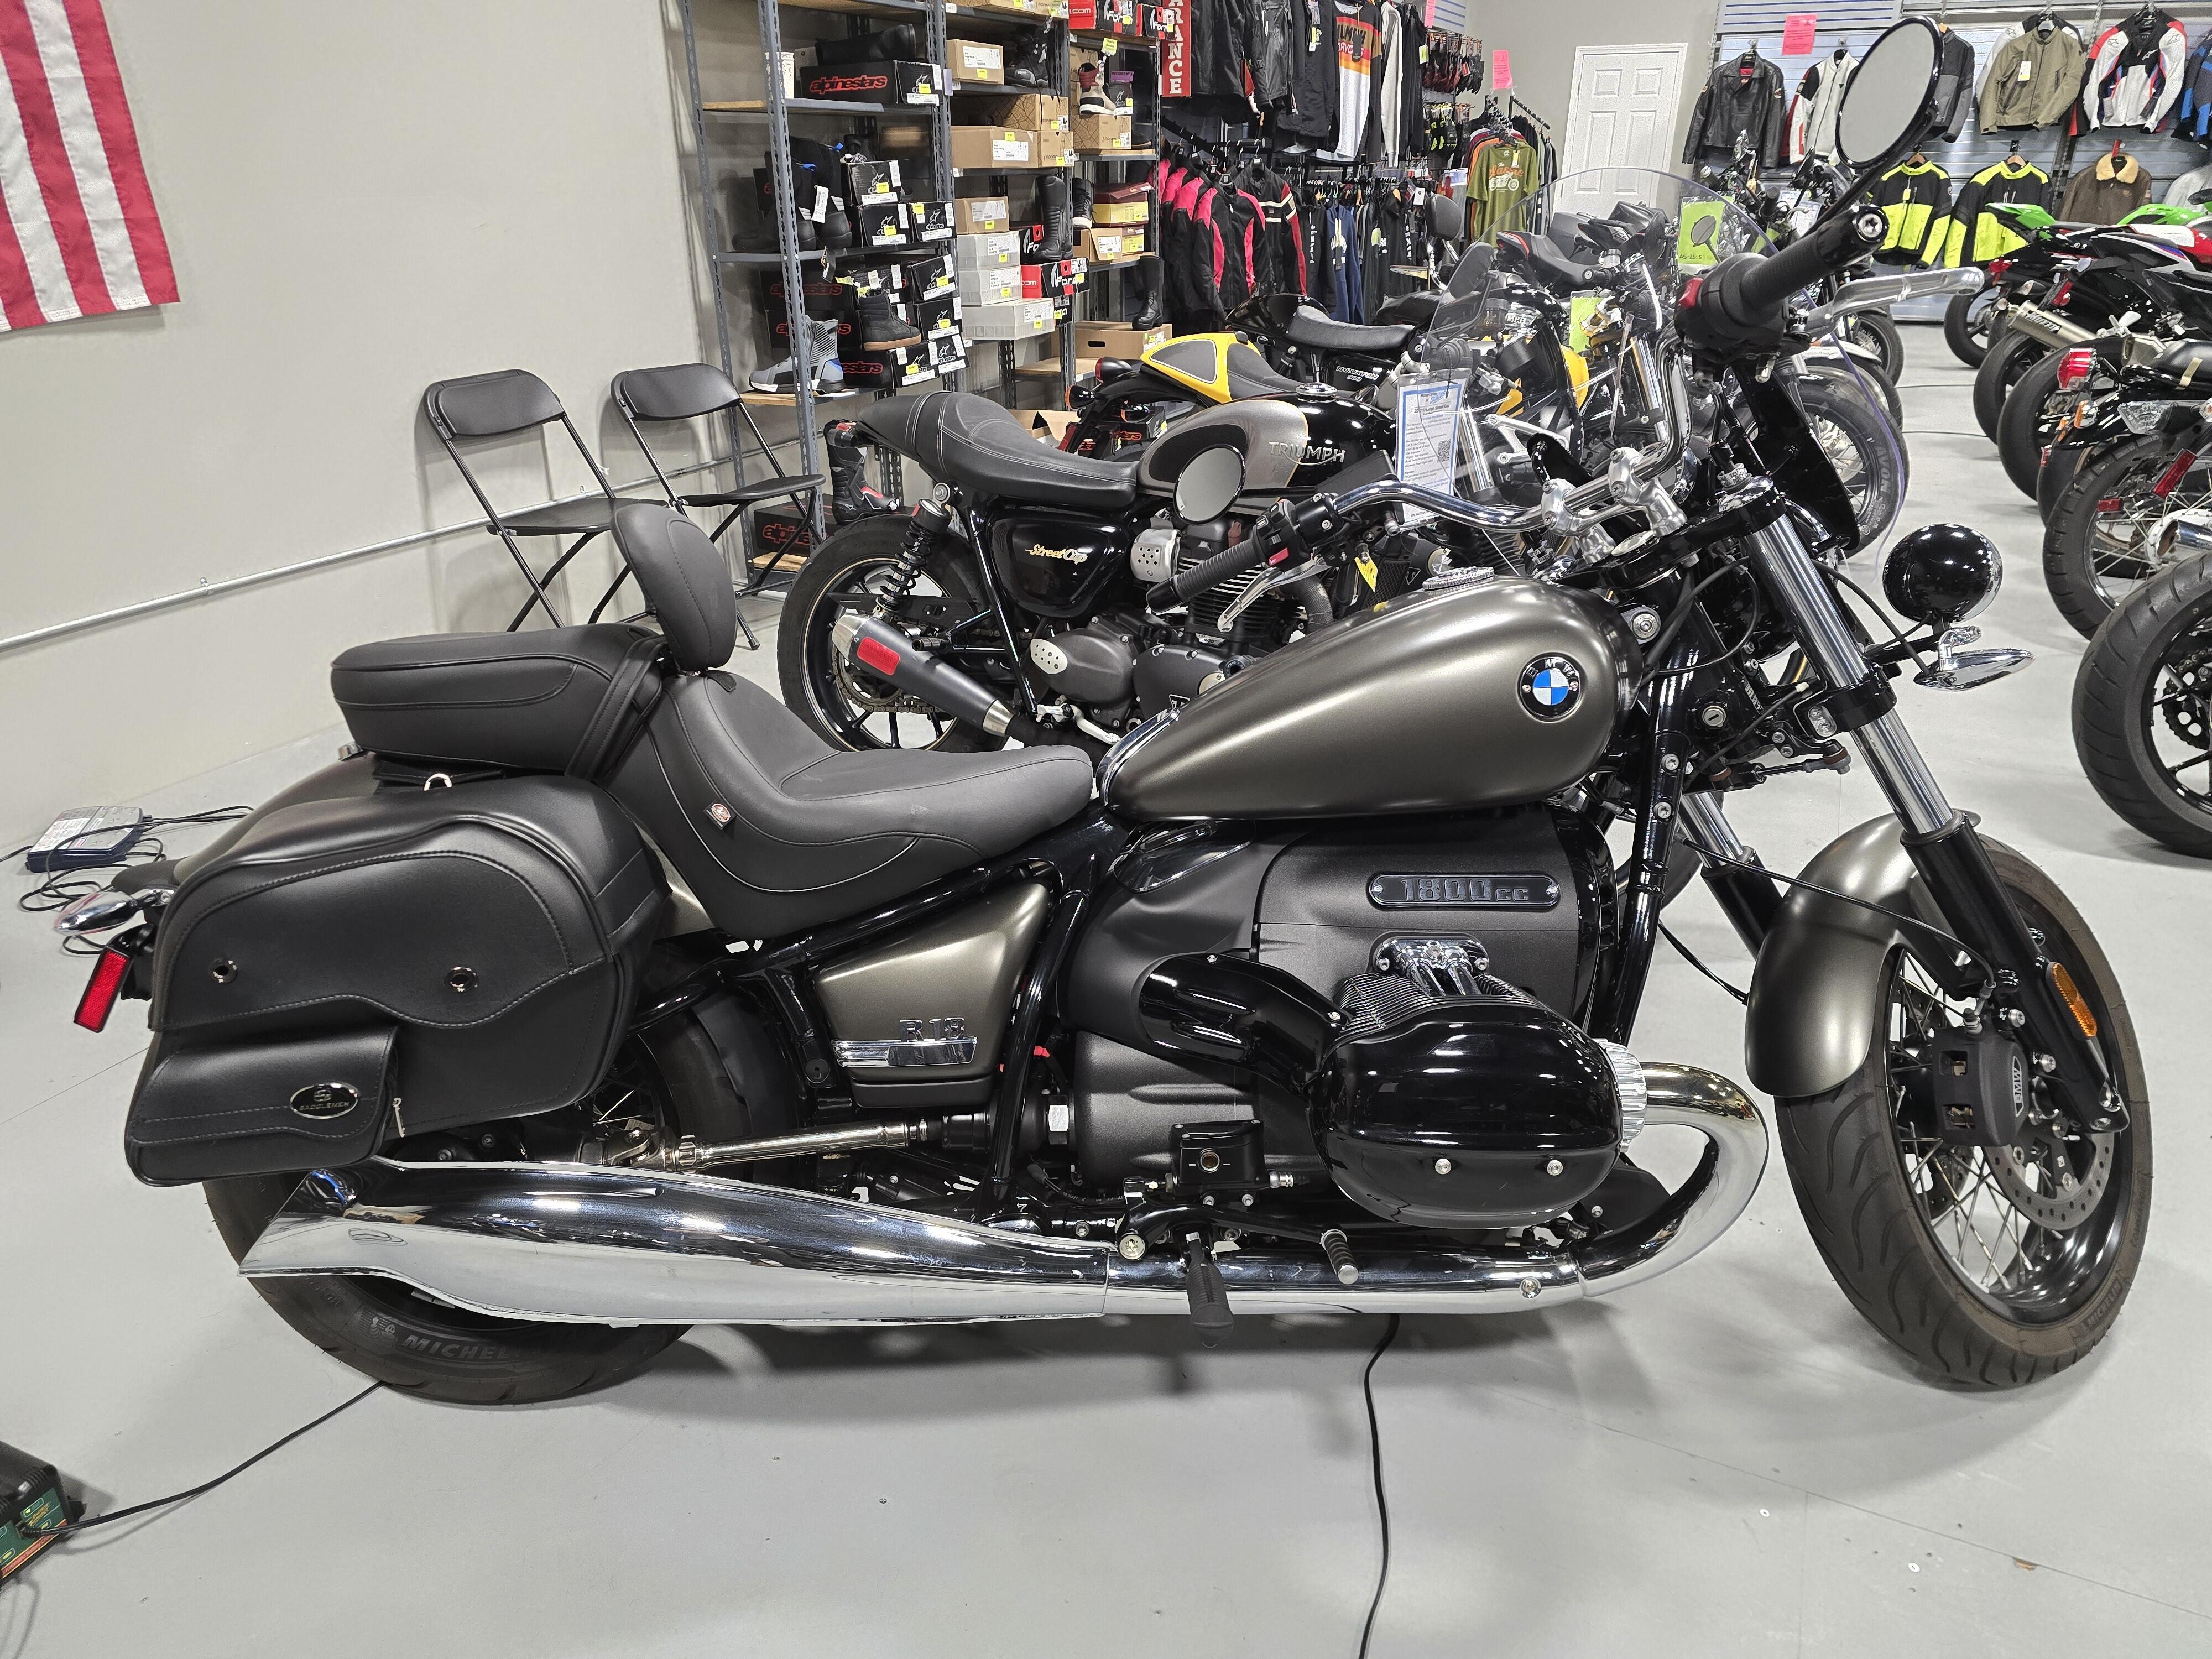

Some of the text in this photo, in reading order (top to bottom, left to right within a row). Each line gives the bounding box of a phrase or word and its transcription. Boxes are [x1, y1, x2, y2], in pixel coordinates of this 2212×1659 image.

[810, 75, 888, 95] alpinestars
[1336, 366, 1379, 380] THRUXTON
[1269, 442, 1345, 462] TRIUMPH
[1526, 659, 1575, 679] BMW
[2013, 1068, 2022, 1103] BMW
[299, 1102, 349, 1111] SADDLEMEN
[403, 1334, 515, 1360] MICHEL
